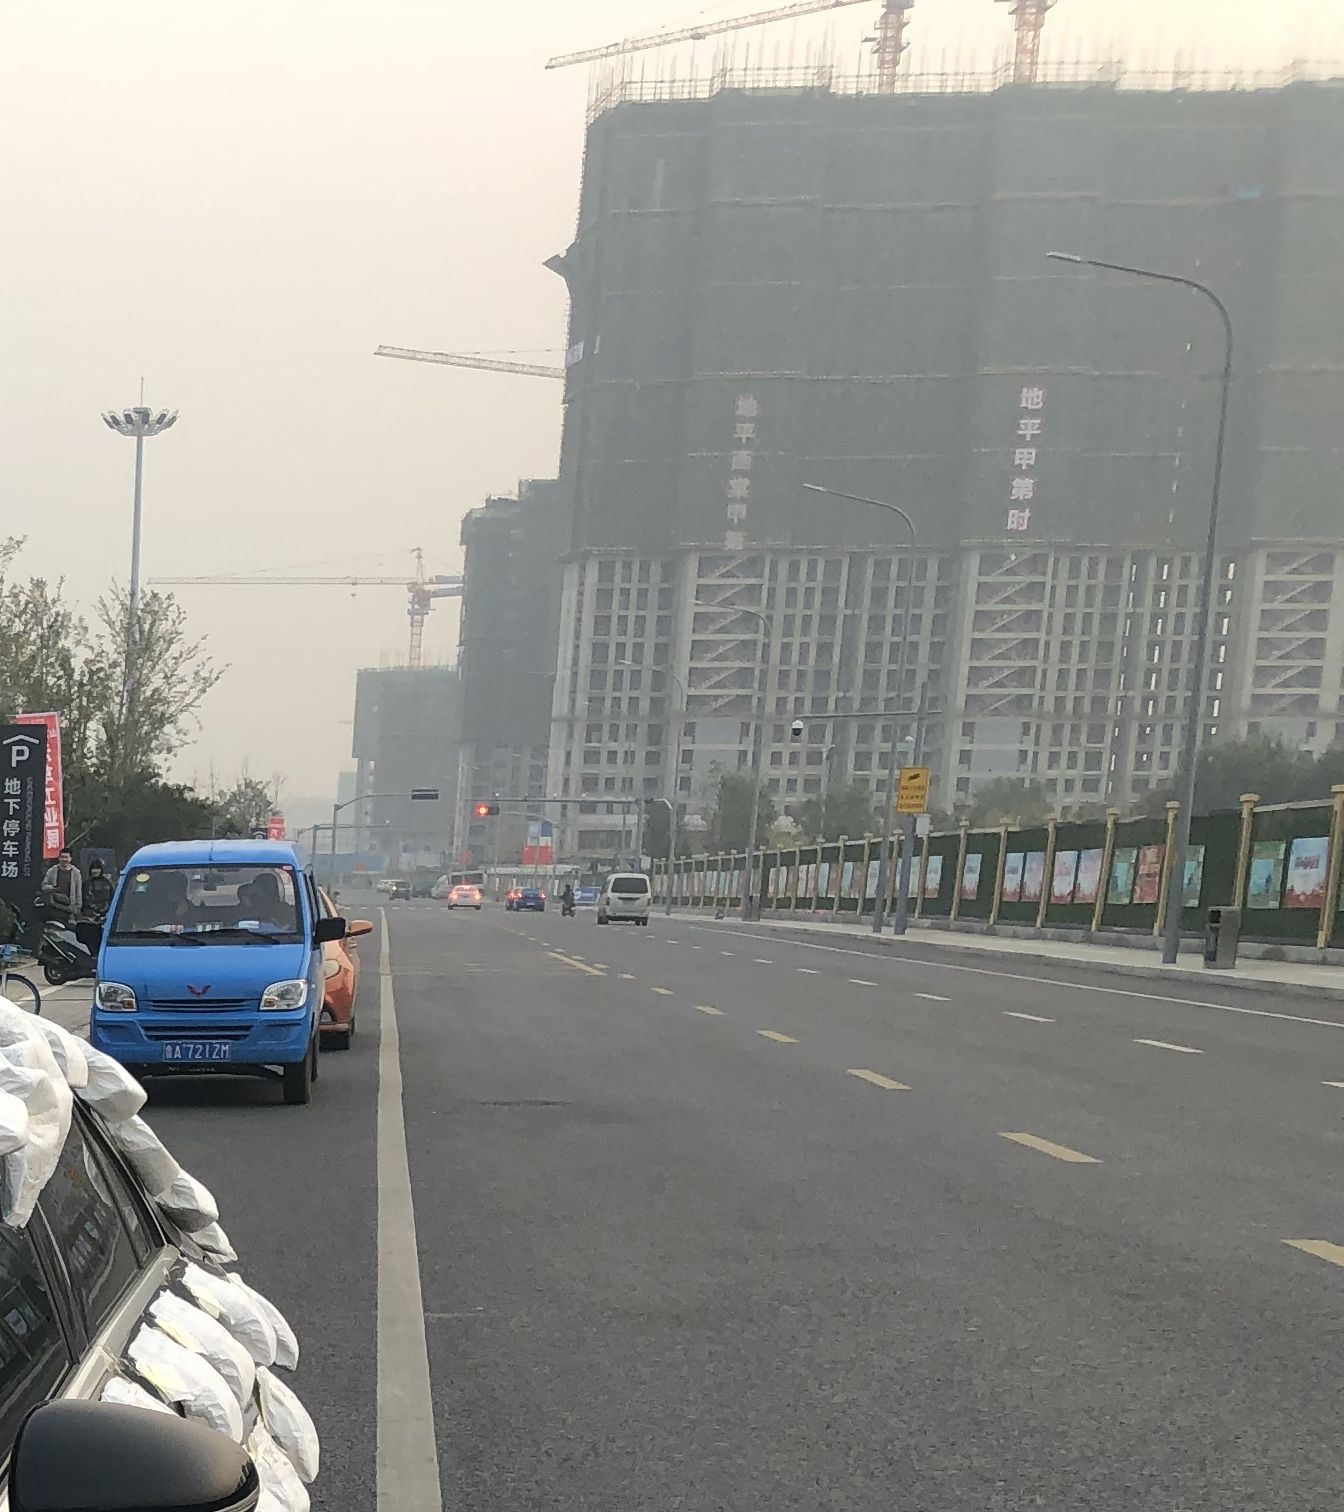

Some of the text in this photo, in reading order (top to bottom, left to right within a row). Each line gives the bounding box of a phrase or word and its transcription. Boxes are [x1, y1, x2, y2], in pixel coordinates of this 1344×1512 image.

[11, 745, 30, 768] P
[1, 777, 22, 878] 地下停车场
